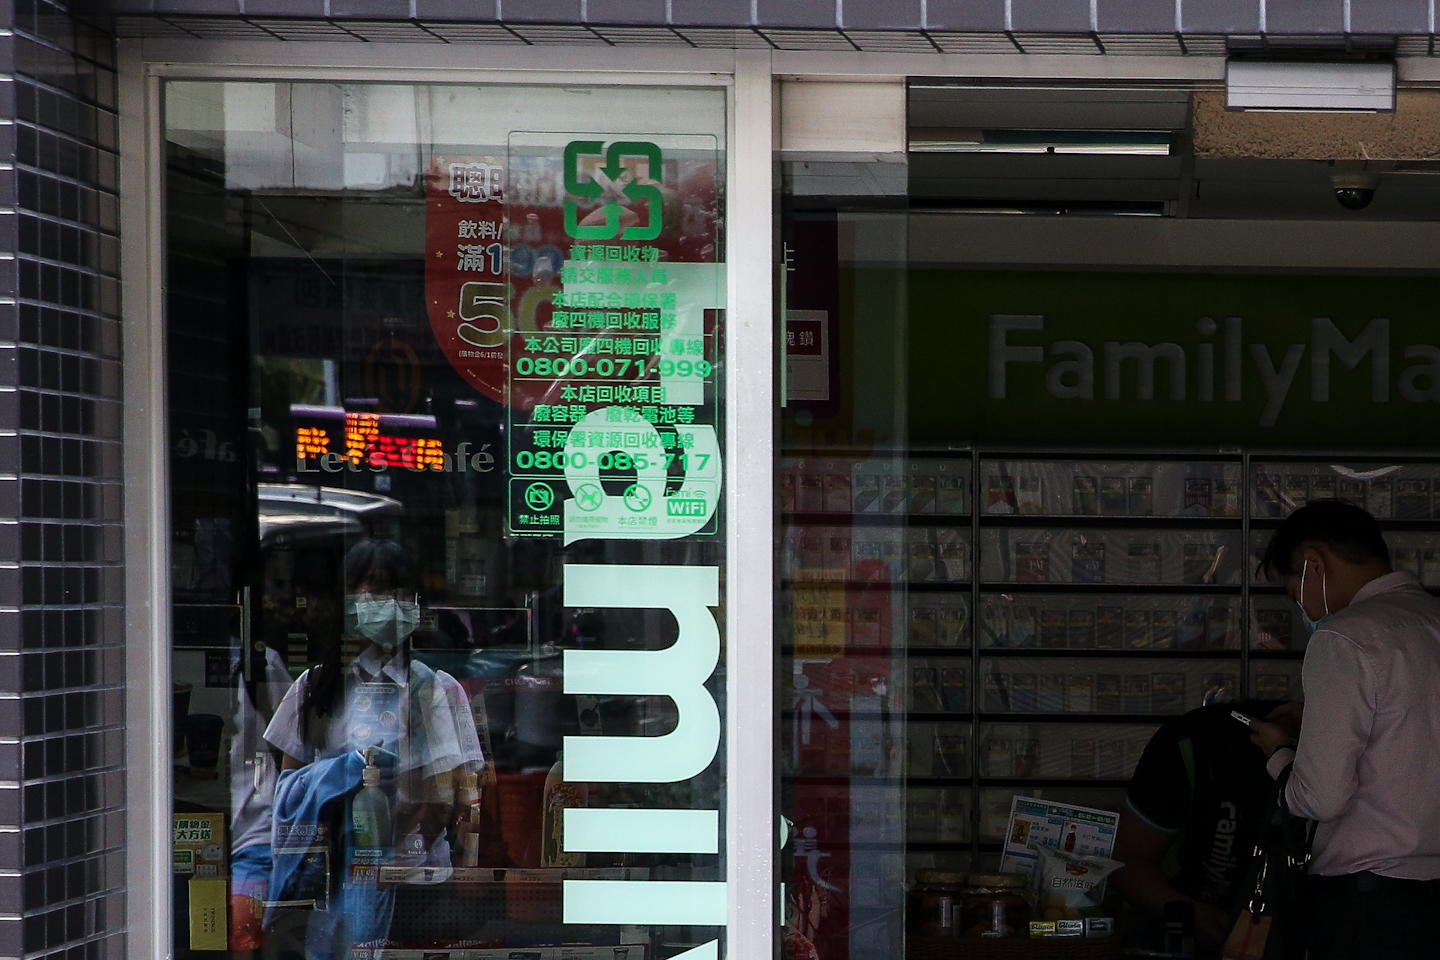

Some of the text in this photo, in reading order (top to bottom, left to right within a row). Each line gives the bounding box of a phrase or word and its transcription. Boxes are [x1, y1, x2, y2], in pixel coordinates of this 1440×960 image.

[570, 245, 659, 263] 資源回收物
[560, 268, 668, 285] 請交服務人員
[552, 292, 676, 311] 本店配合環保署
[551, 311, 677, 330] 廢四機回收服務
[525, 337, 704, 356] 本公司廢四機回收專線
[516, 358, 712, 378] 0800-071-999
[561, 385, 667, 403] 本店回收項目
[533, 405, 695, 424] 廢容器、廢乾電池等
[533, 430, 695, 450] 環保署資源回收專線
[516, 451, 711, 472] 0800-085-717
[669, 501, 705, 515] WiFi
[519, 514, 560, 525] 禁止拍照
[1053, 877, 1094, 889] 自然滋味
